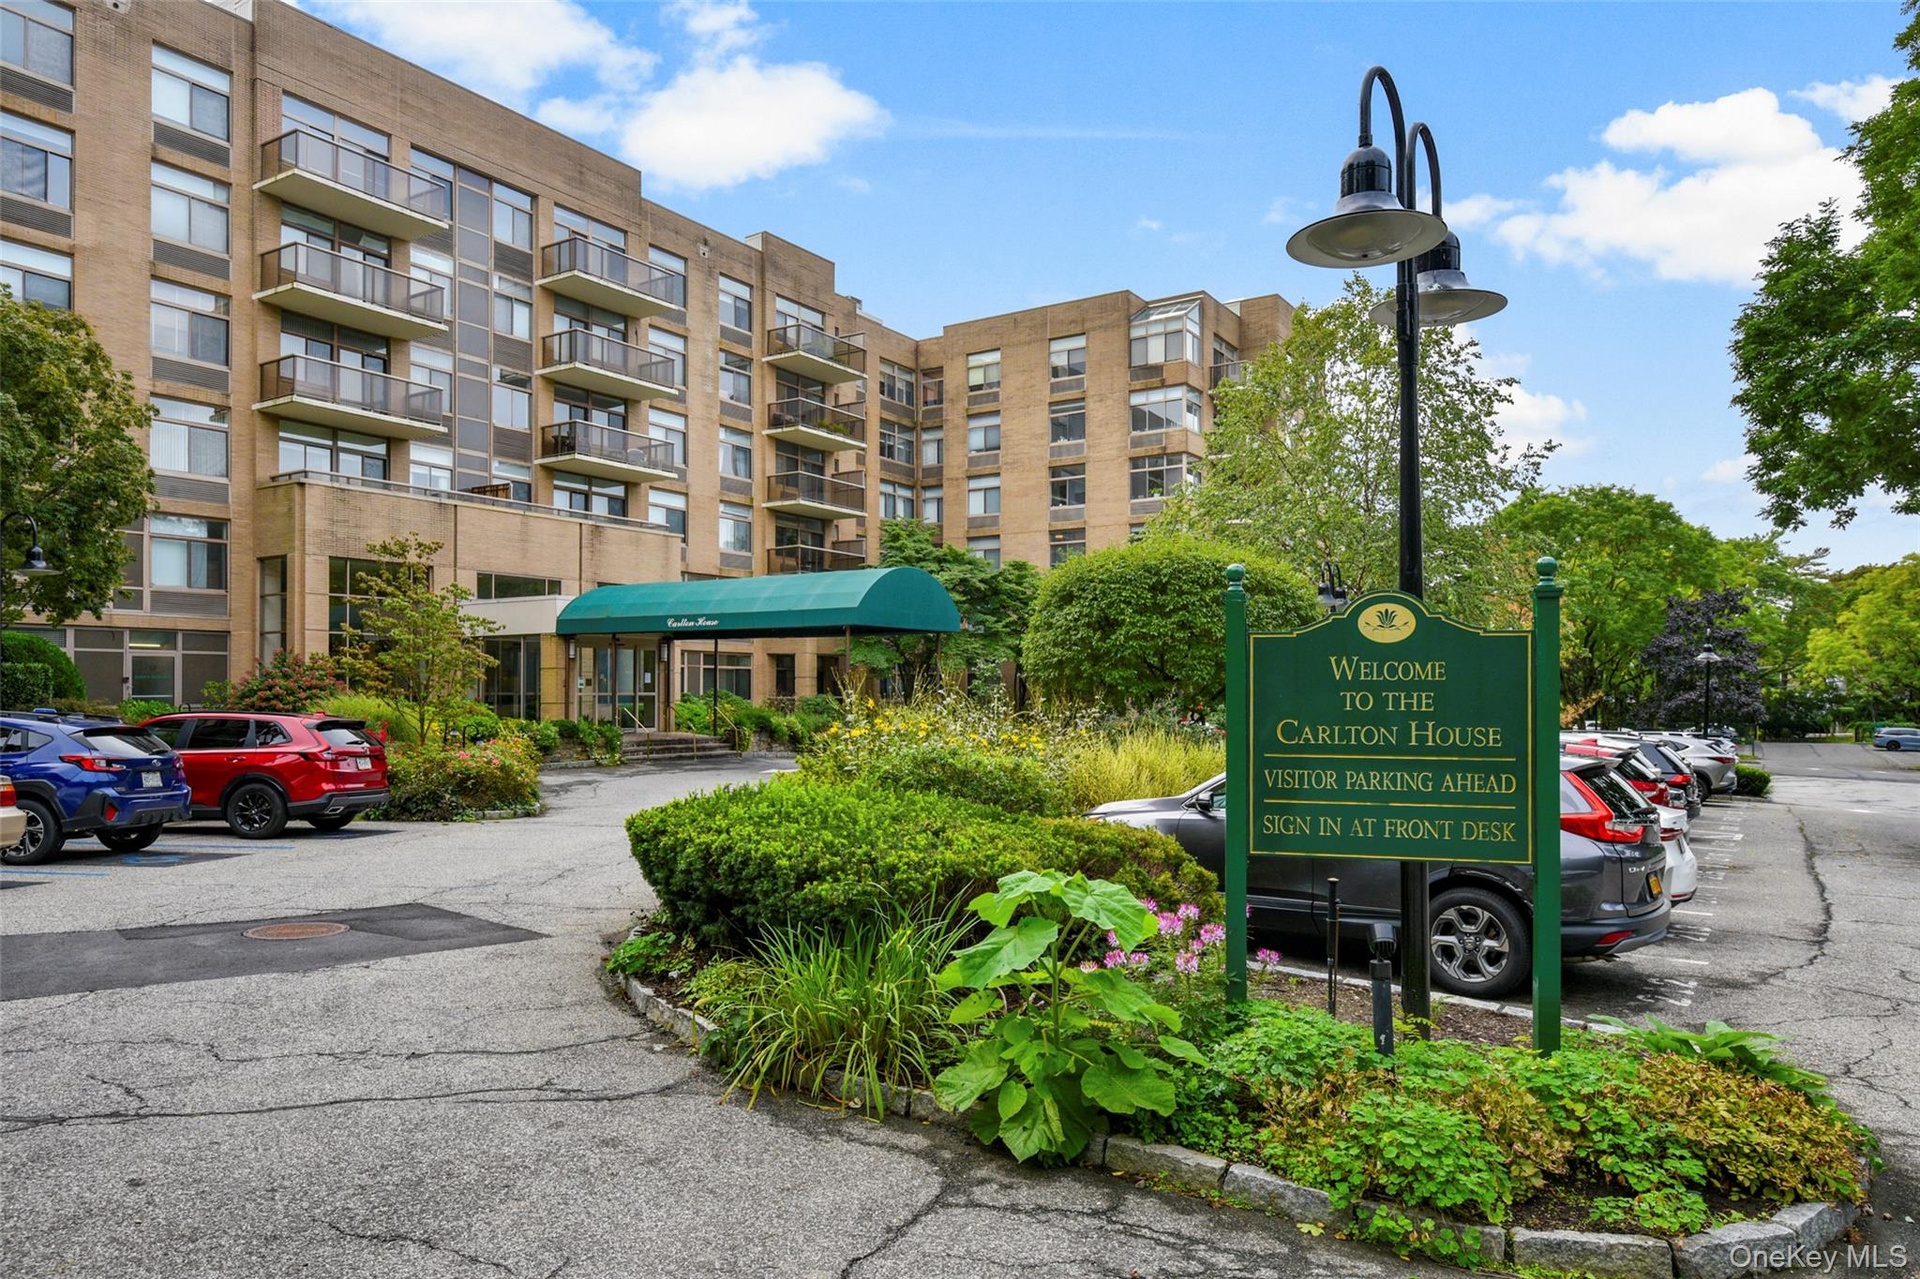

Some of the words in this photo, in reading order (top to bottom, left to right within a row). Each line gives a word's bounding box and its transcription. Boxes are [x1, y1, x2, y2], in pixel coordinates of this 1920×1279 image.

[1340, 691, 1374, 711] TO
[1382, 692, 1434, 712] THE
[1264, 769, 1338, 790] VISITOR
[1345, 770, 1433, 792] PARKING
[1440, 773, 1517, 794] AHEAD
[1263, 814, 1311, 836] SIGN
[1319, 816, 1342, 837] IN
[1351, 818, 1377, 838] AT
[1384, 818, 1454, 841] FRONT
[1462, 821, 1516, 843] DESK
